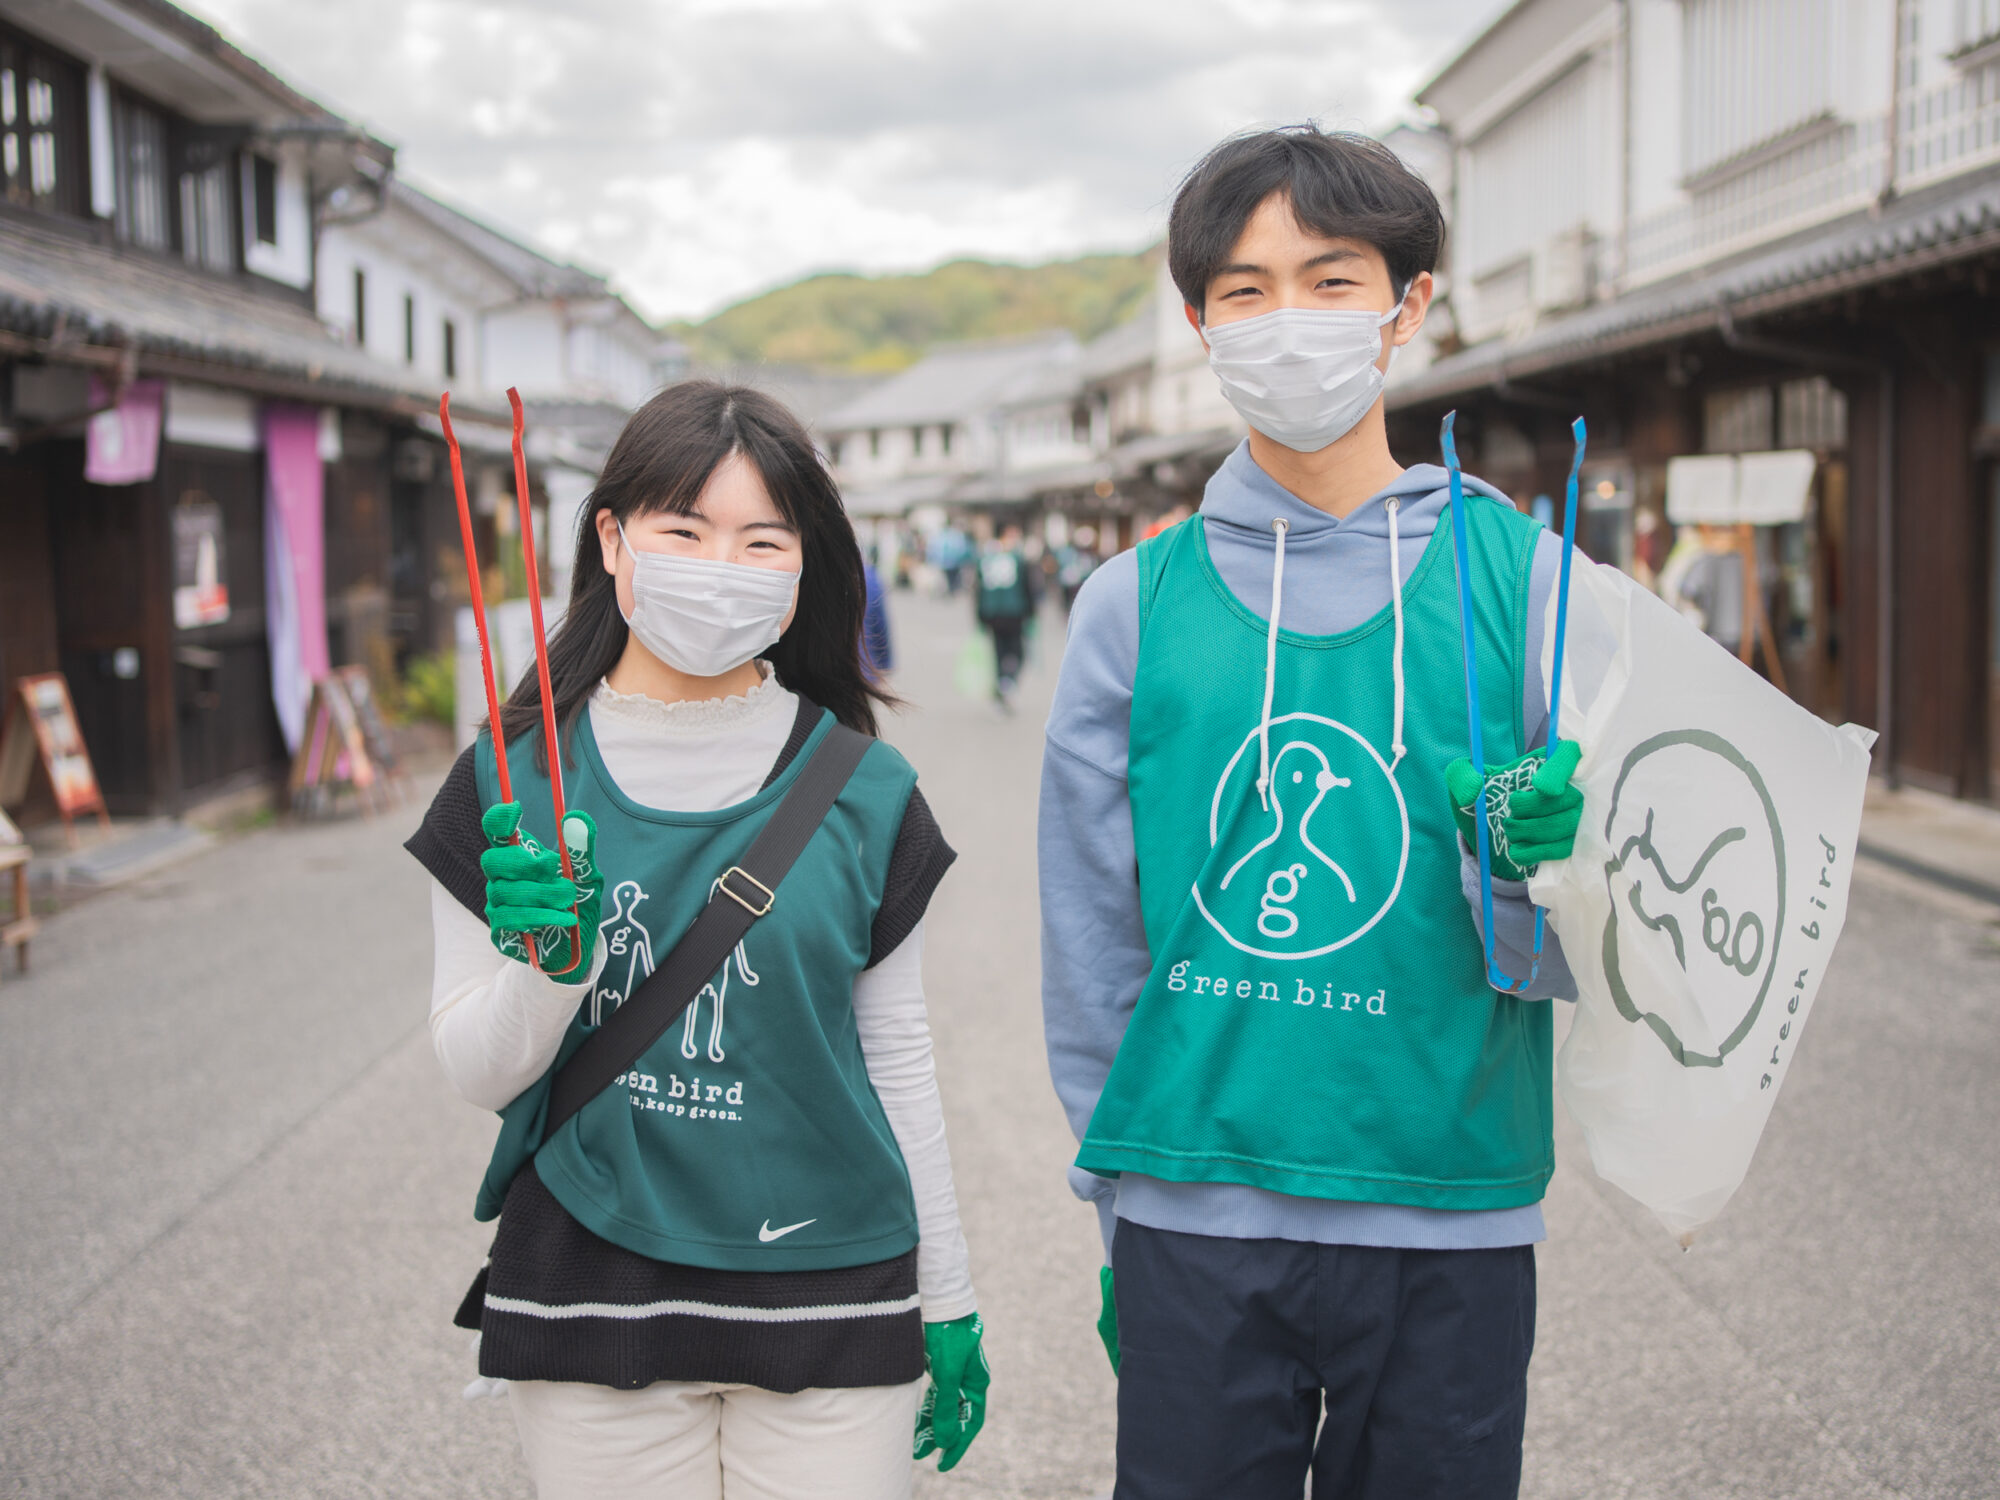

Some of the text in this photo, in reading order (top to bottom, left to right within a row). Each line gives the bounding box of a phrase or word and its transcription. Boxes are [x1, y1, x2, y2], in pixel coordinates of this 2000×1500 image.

[1257, 863, 1308, 938] g
[610, 926, 632, 955] g
[1761, 833, 1836, 1090] green bird
[1168, 960, 1386, 1015] green bird
[668, 1074, 744, 1105] bird
[689, 1106, 742, 1121] green.
